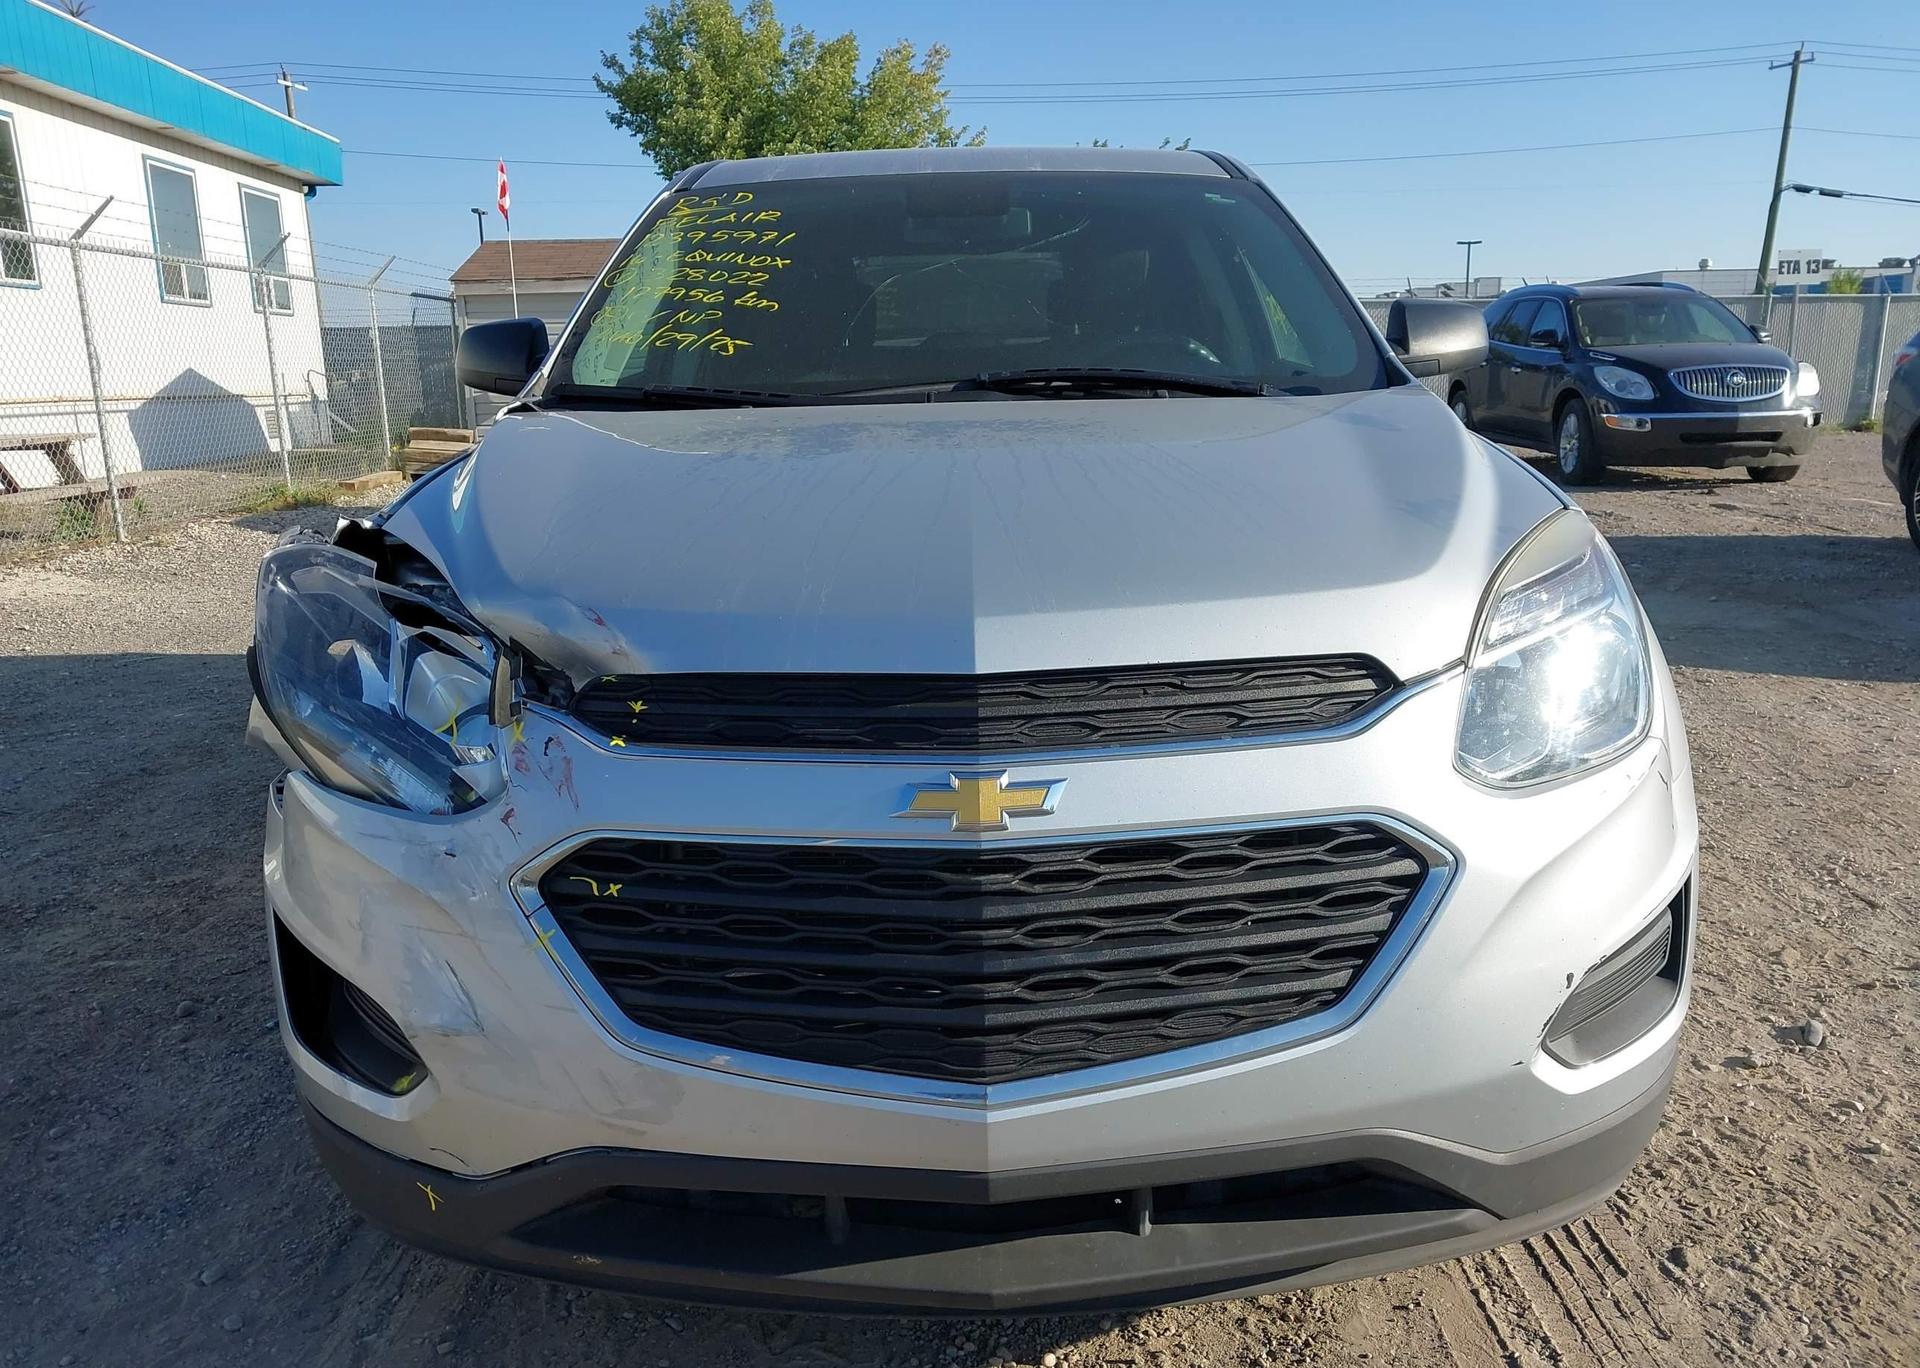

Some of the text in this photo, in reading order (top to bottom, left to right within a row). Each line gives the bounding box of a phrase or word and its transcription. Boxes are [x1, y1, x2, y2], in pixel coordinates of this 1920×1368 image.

[666, 249, 792, 269] EQUINOX
[1778, 258, 1820, 275] ETA 13
